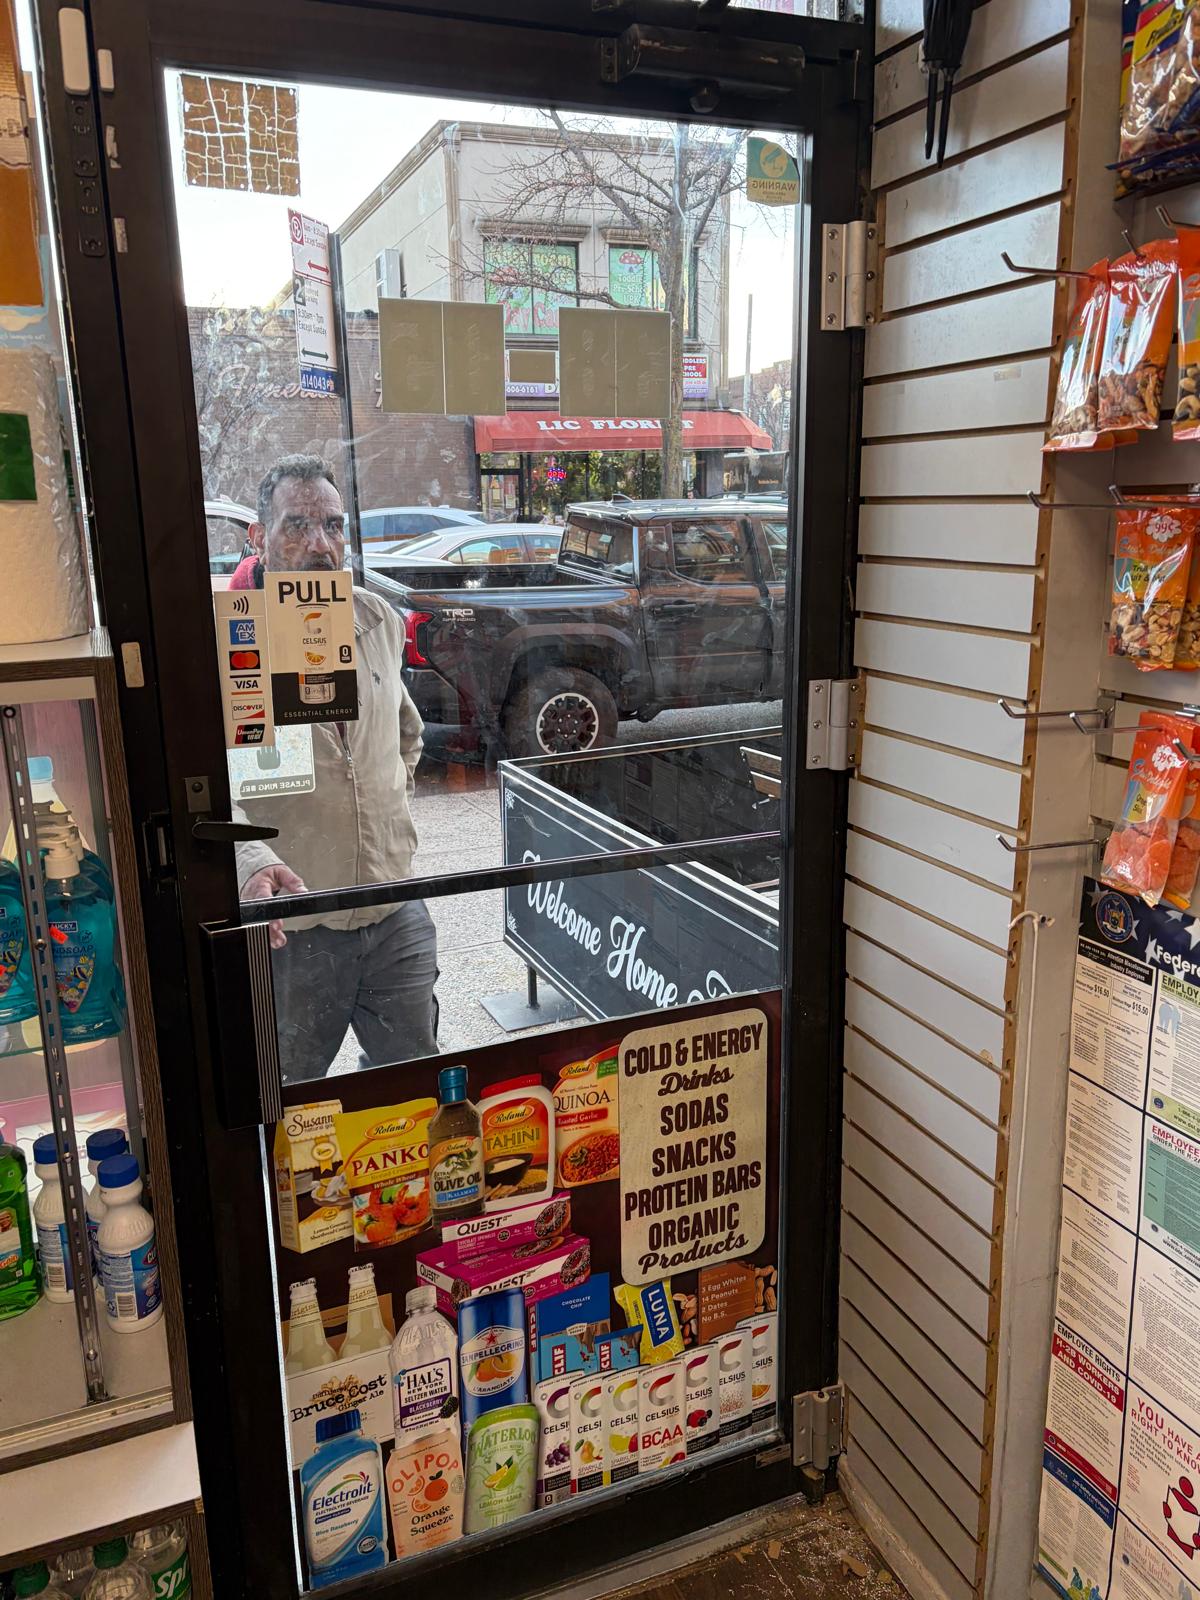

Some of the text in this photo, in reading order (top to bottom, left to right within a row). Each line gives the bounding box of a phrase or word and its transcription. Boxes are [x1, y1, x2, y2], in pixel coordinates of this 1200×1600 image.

[618, 274, 645, 283] Toddle
[294, 279, 304, 303] 2
[536, 419, 694, 431] LIC FLORIT
[547, 470, 567, 481] OPEN
[278, 580, 346, 604] PULL
[236, 624, 255, 632] AM
[238, 632, 255, 640] EX
[303, 637, 327, 645] CELSIUS
[234, 680, 259, 689] VISA
[233, 704, 263, 712] DISCOVER
[284, 708, 353, 718] ESSENTIAL ENERGY
[237, 727, 263, 736] UnionPay
[521, 850, 678, 1008] Welcome Home
[1125, 968, 1145, 981] Employees
[1162, 975, 1200, 999] EMPLOY
[624, 1042, 672, 1077] COLD
[675, 1037, 688, 1066] &
[692, 1022, 764, 1062] ENERGY
[566, 1064, 591, 1075] Roland
[657, 1063, 734, 1096] Drinks
[553, 1089, 611, 1113] QUINOA
[287, 1113, 334, 1136] Susann
[496, 1108, 526, 1122] Roland
[580, 1112, 599, 1121] Garlic
[660, 1093, 729, 1136] SODAS
[374, 1122, 407, 1135] Roland
[485, 1127, 540, 1151] TAHINI
[1152, 1125, 1200, 1158] EMPLOYEE
[1153, 1134, 1172, 1148] UNDER
[1174, 1145, 1185, 1155] THE
[352, 1143, 429, 1177] PANKO
[652, 1131, 737, 1177] SNACKS
[374, 1173, 416, 1189] Whole Wheat
[434, 1172, 482, 1192] OLIVE OIL
[624, 1160, 761, 1221] PROTEIN BARS
[457, 1216, 502, 1236] QUEST
[648, 1202, 740, 1250] ORGANIC
[638, 1231, 749, 1274] Products
[420, 1264, 438, 1283] QUEST
[708, 1283, 721, 1292] Egg
[722, 1275, 746, 1288] Whites
[562, 1296, 591, 1306] CHOCOLATE
[710, 1288, 738, 1301] Peanuts
[648, 1289, 670, 1340] LUNA
[708, 1301, 728, 1311] Dates
[713, 1311, 727, 1319] B.S.
[555, 1347, 566, 1376] CLIF
[600, 1344, 610, 1369] CLIF
[752, 1356, 773, 1369] LSIUS
[1057, 1325, 1120, 1382] EMPLOYEE RIGHTS
[1056, 1338, 1120, 1395] H-2B WORKERS
[1058, 1350, 1117, 1403] AND COVID-19
[407, 1368, 444, 1389] HAL'S
[407, 1381, 443, 1395] NEW YORK
[719, 1371, 745, 1386] ELSIUS
[290, 1374, 387, 1422] Bruce Cost
[337, 1389, 384, 1412] Ginger Ale
[405, 1386, 447, 1403] SELTZER WATER
[686, 1387, 713, 1401] ELSIUS
[409, 1398, 443, 1414] BLACKBERRY
[645, 1405, 680, 1422] CELSIUS
[543, 1421, 569, 1435] CELSI
[577, 1420, 602, 1434] CELSI
[1131, 1408, 1158, 1436] RIGHT
[1162, 1434, 1173, 1450] TO
[1137, 1397, 1193, 1455] YOU HAVE
[476, 1427, 536, 1457] WATERLOO
[642, 1424, 683, 1449] BCAA
[392, 1453, 459, 1493] OLIPOP
[313, 1481, 373, 1511] Electrolit
[315, 1496, 369, 1516] ELECTROLYTE BEVERAGE
[330, 1518, 359, 1531] Raspberry
[410, 1513, 454, 1536] Squeeze
[411, 1505, 451, 1526] Orange
